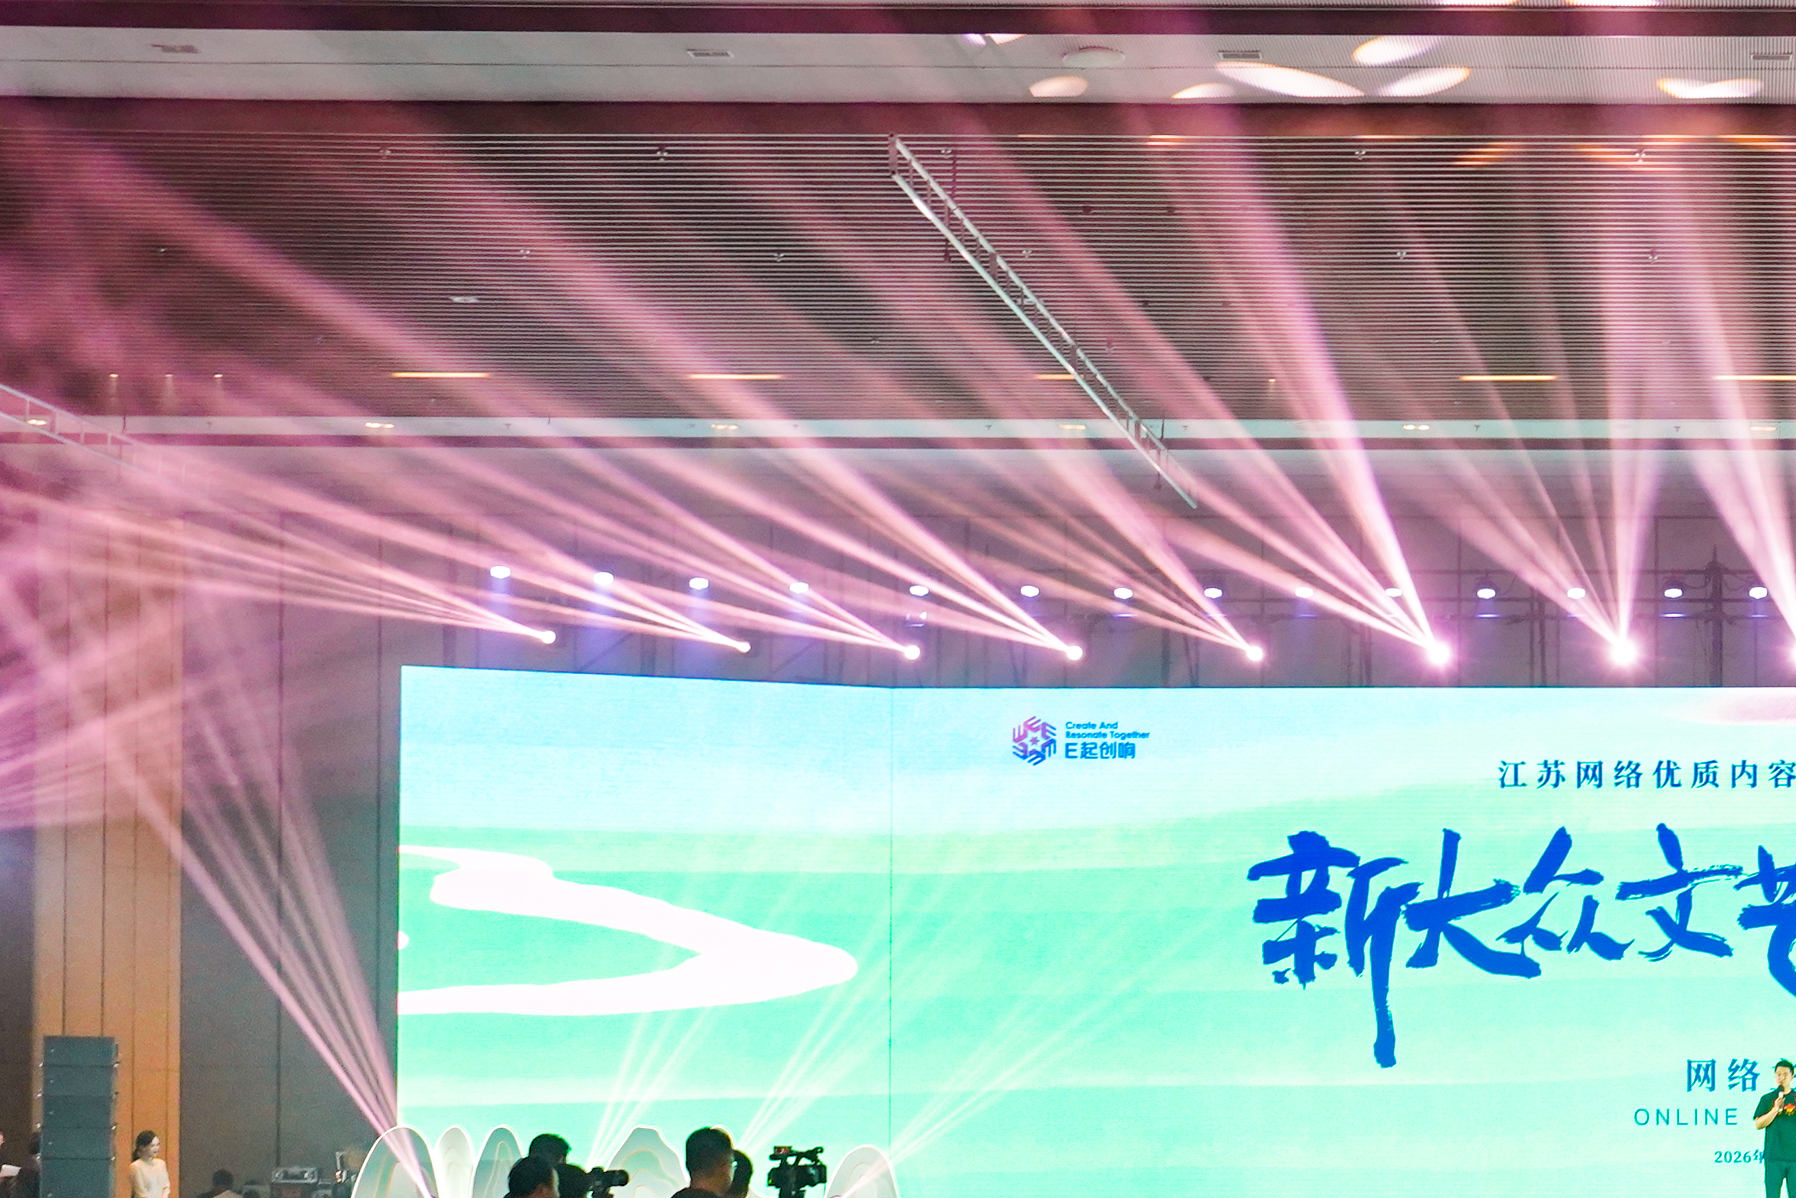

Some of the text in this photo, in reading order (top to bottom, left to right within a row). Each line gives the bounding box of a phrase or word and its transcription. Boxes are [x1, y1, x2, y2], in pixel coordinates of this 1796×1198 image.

[1065, 721, 1119, 729] Create And
[1065, 731, 1150, 740] Resonate Together
[1065, 742, 1136, 759] E起创响
[1634, 1108, 1738, 1126] ONLINE
